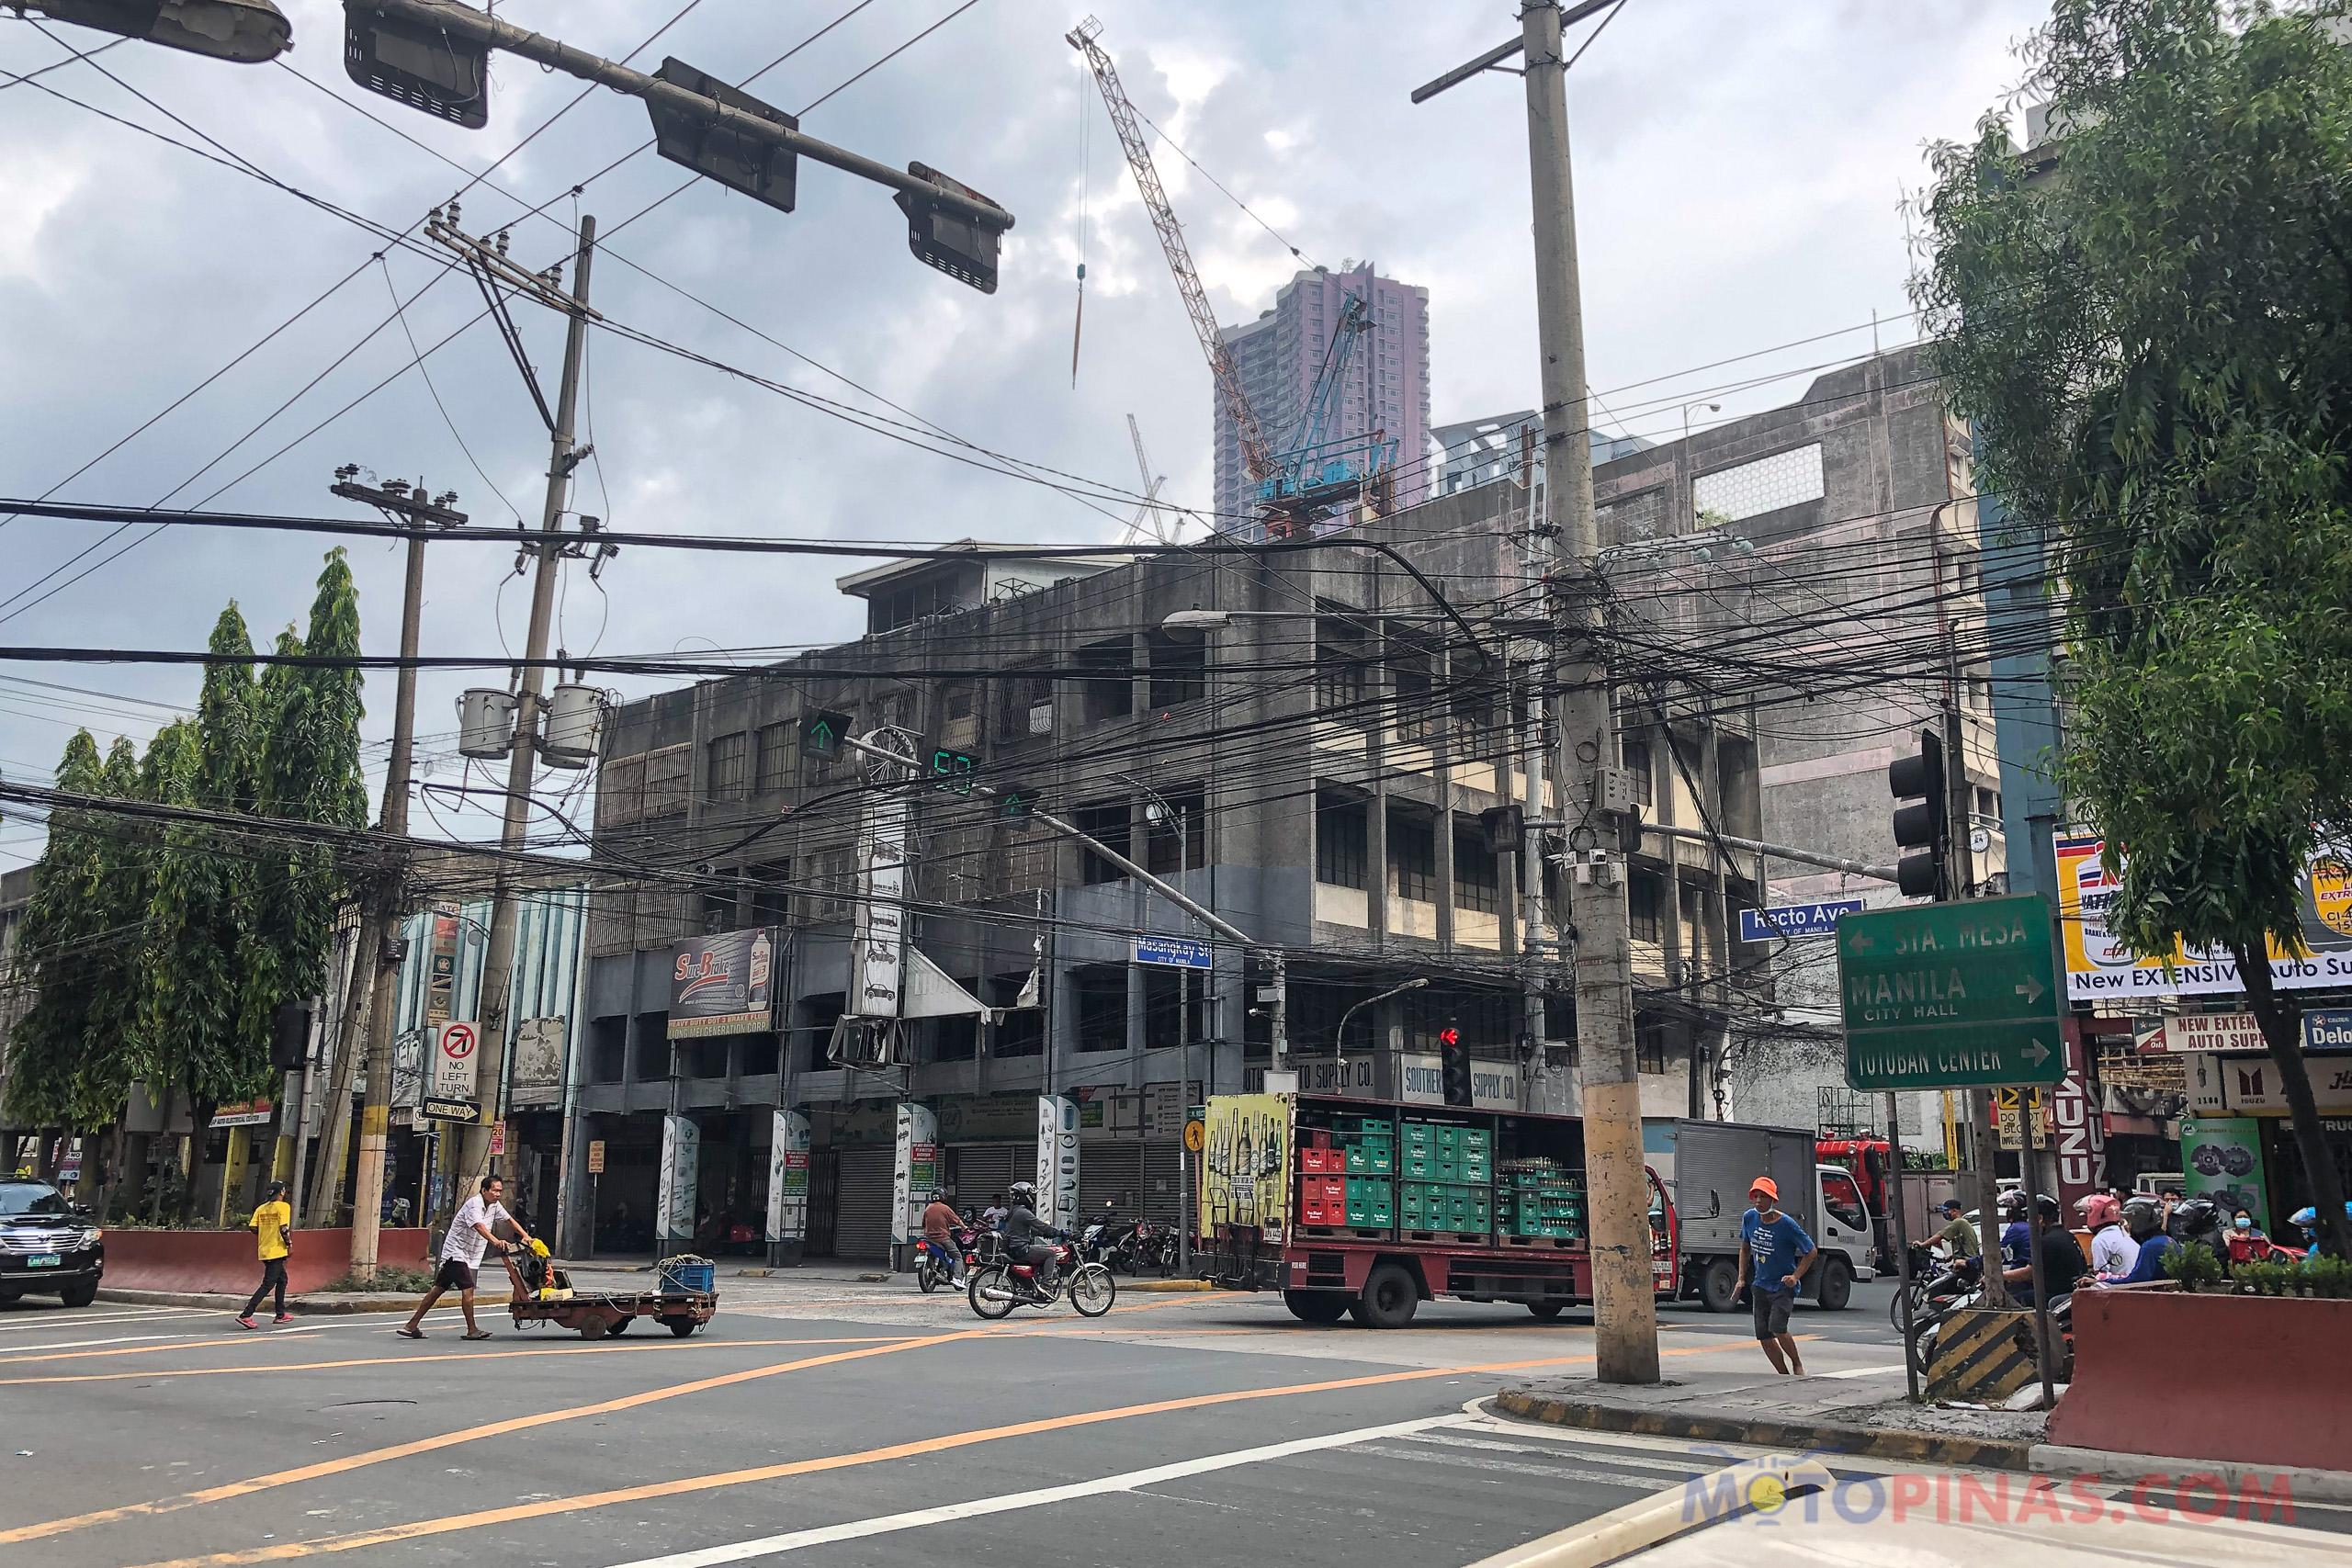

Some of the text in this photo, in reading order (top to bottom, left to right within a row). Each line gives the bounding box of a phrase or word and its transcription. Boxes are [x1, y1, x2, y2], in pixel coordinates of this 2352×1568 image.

[1754, 908, 1806, 929] Recto
[1895, 915, 2027, 954] STA. MESA
[1138, 937, 1194, 960] Masangkay
[2075, 970, 2124, 989] New
[2132, 964, 2236, 987] EXTENSIV
[1851, 967, 1966, 1006] MANILA
[690, 1017, 706, 1025] DUTY
[708, 1015, 720, 1024] DOT
[728, 1014, 748, 1022] BRAKE
[1864, 1004, 1958, 1021] CITY HALL
[705, 1023, 745, 1036] GENERATION
[2177, 1015, 2256, 1032] NEW EXTEN
[2188, 1032, 2266, 1048] AUTO SUPP
[448, 1061, 464, 1071] NO
[1858, 1049, 2001, 1077] TUTUBAN CENTER
[442, 1072, 469, 1081] LEFT
[1357, 1061, 1374, 1087] CO.
[439, 1083, 469, 1093] TURN
[1406, 1066, 1516, 1100] SOUTHER SUPPLY CO.
[428, 1104, 472, 1117] ONE WAY
[2000, 1112, 2016, 1122] DO
[493, 1128, 503, 1136] 20
[2004, 1123, 2039, 1134] BLOK
